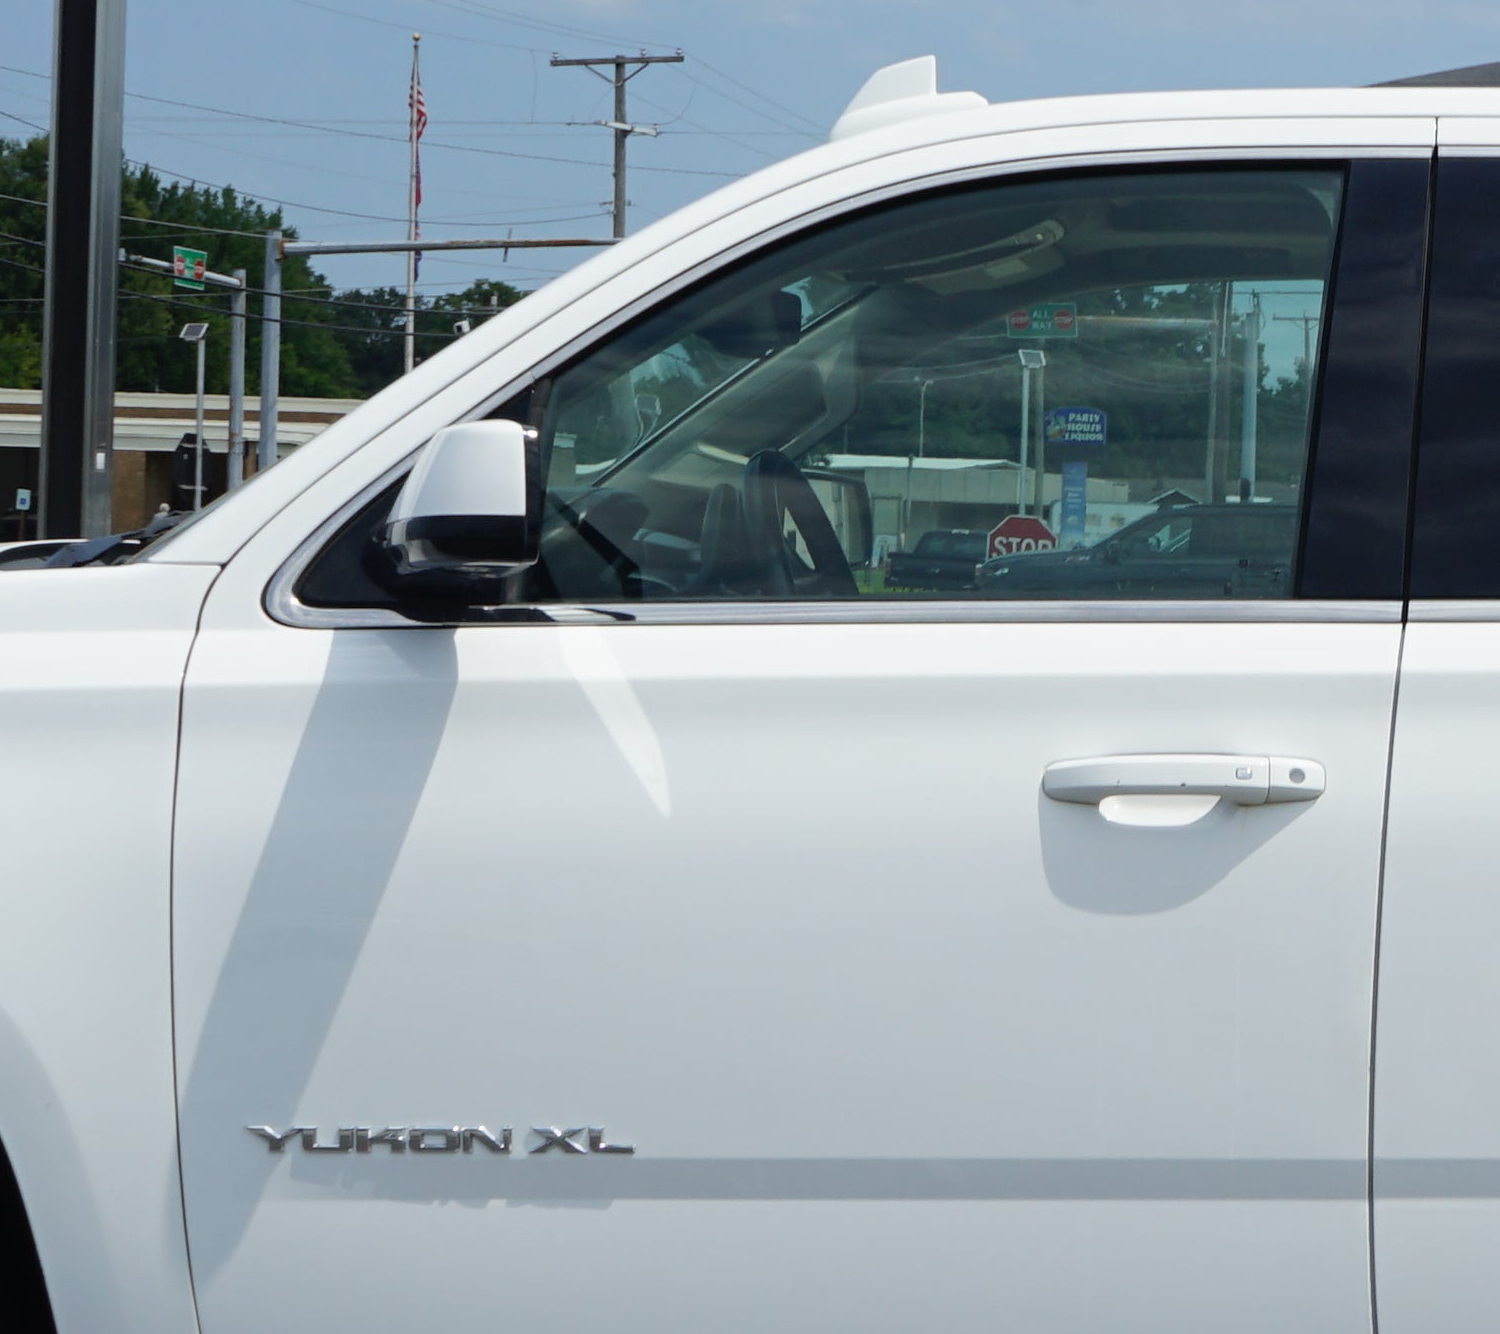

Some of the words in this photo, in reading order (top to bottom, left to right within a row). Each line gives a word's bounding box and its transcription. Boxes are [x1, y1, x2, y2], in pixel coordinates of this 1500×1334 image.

[1068, 413, 1100, 422] PARTY
[1066, 423, 1102, 433] HOUSE
[1064, 433, 1104, 442] LIQUOR
[992, 536, 1052, 556] STOP
[245, 1124, 513, 1153] YUKON
[528, 1124, 636, 1154] XL
